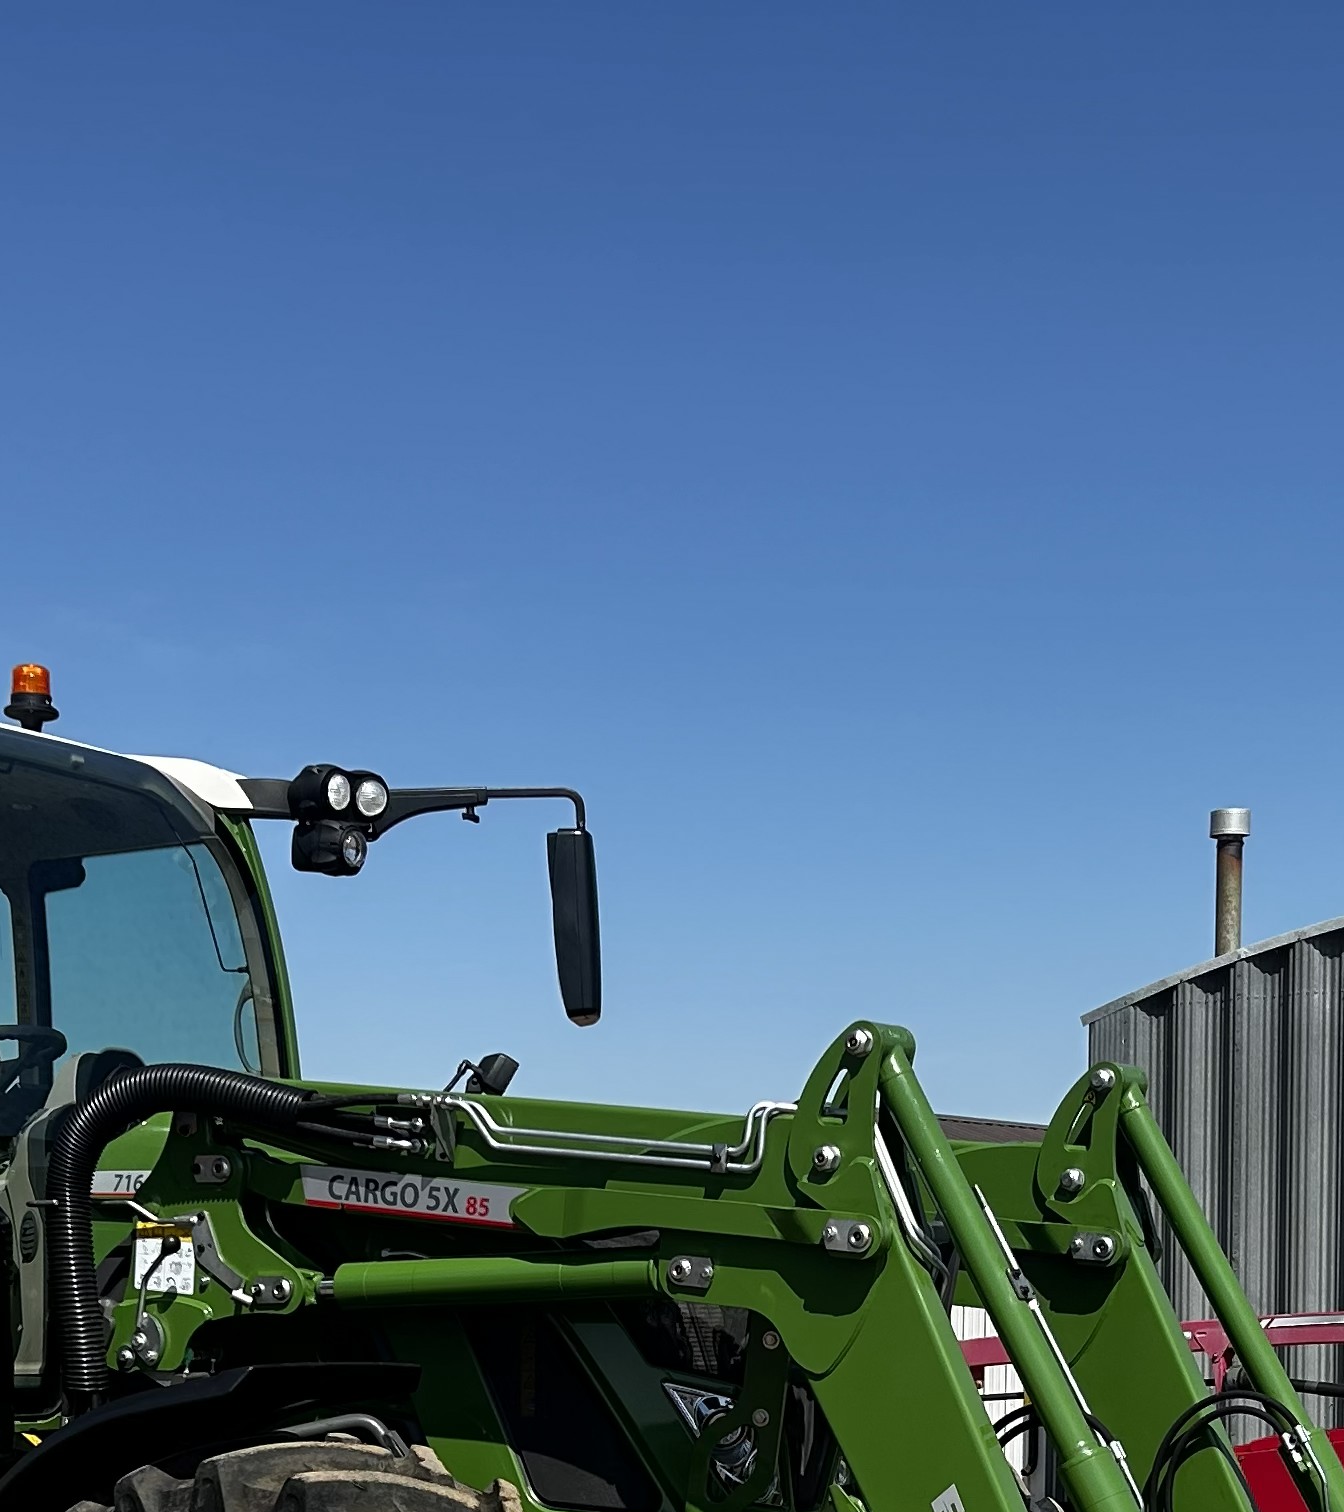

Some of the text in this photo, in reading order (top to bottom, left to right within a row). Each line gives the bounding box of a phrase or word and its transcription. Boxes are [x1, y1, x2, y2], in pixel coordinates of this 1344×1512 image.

[113, 1174, 144, 1192] 716
[328, 1174, 490, 1217] CARGO 5X 85
